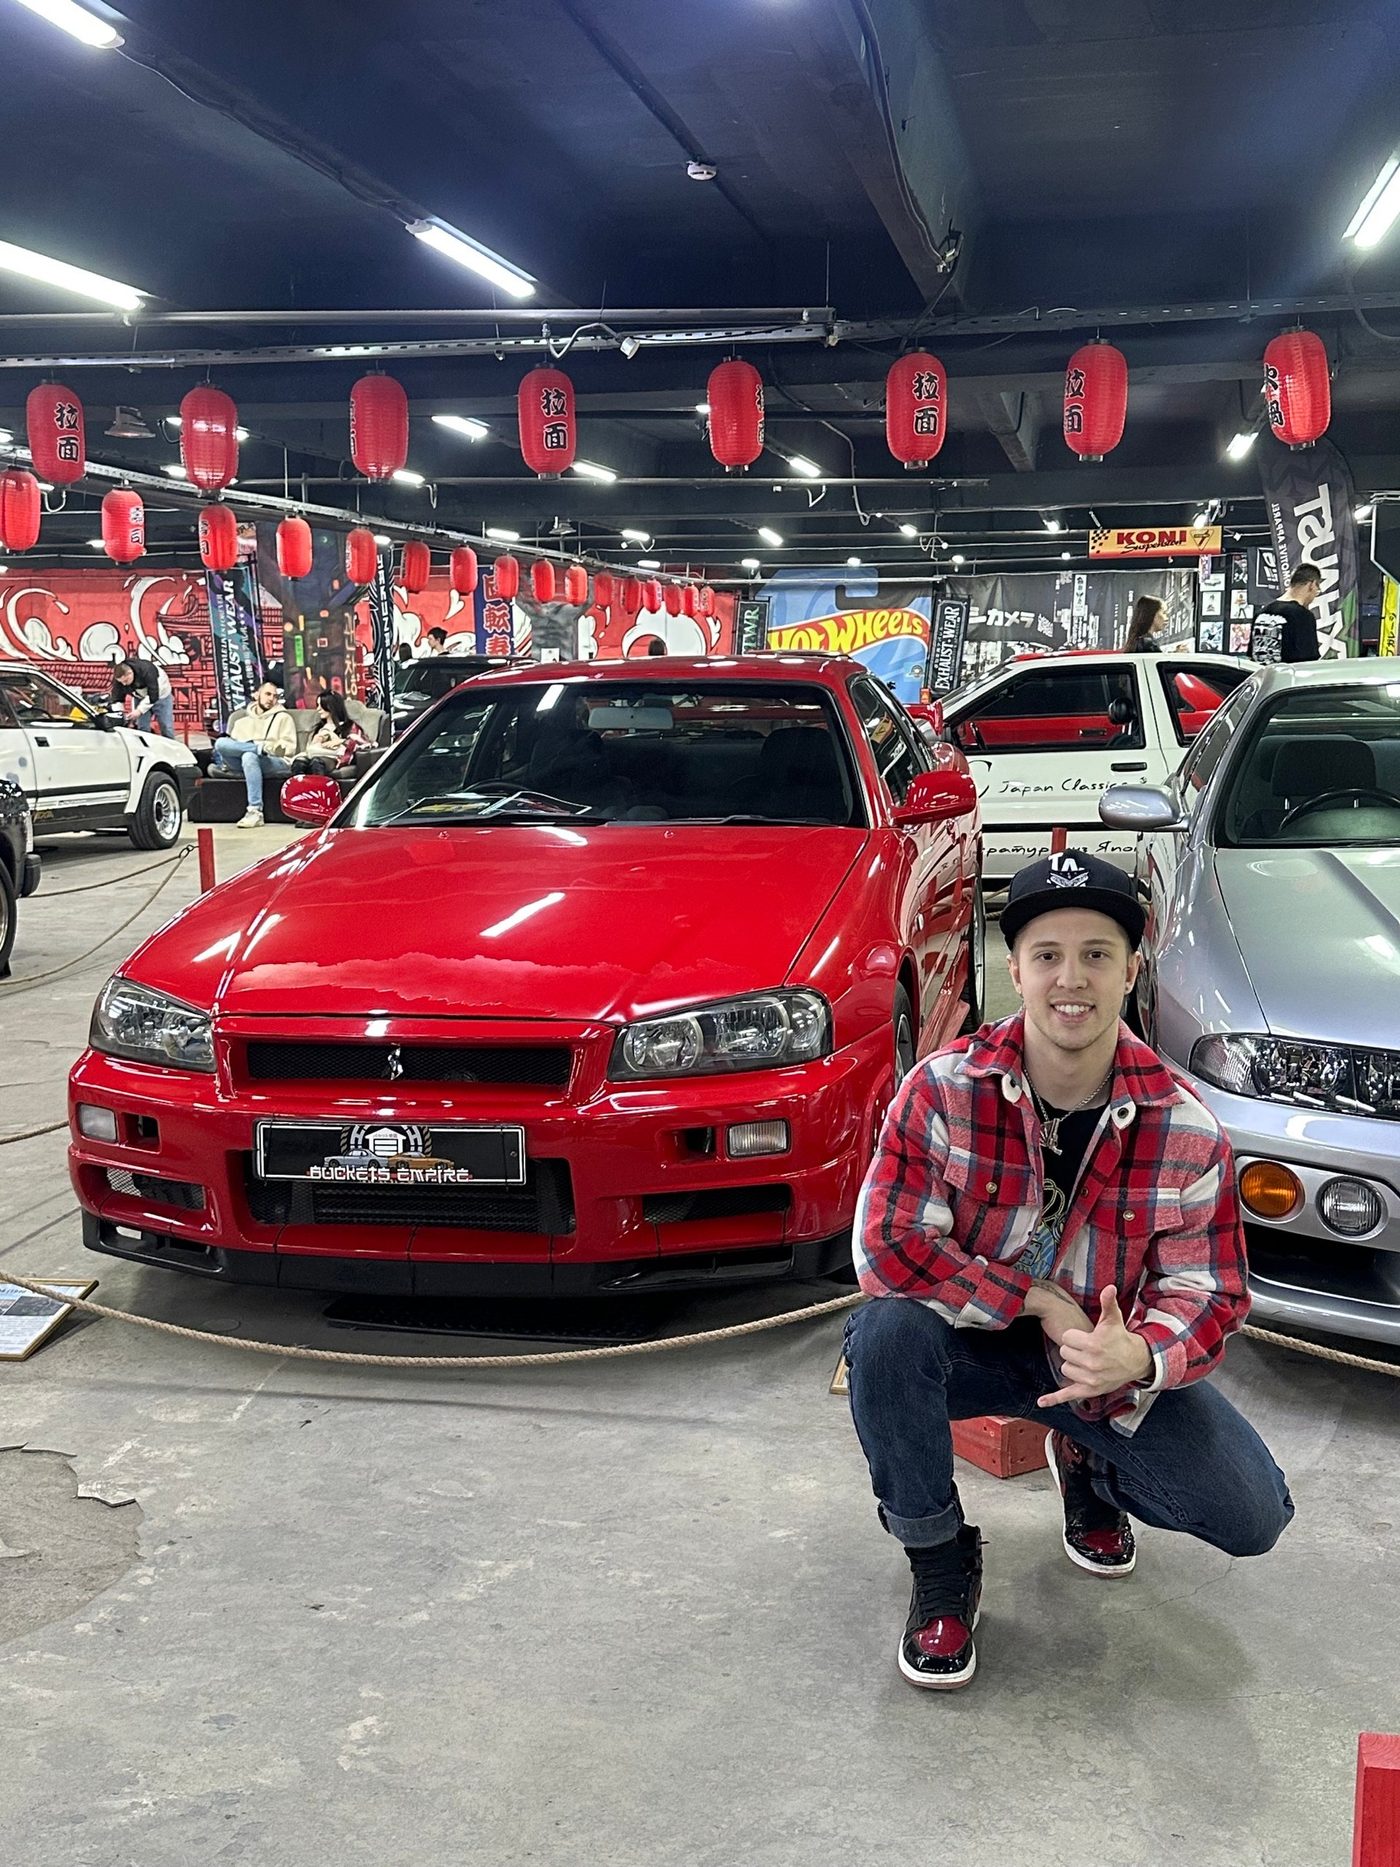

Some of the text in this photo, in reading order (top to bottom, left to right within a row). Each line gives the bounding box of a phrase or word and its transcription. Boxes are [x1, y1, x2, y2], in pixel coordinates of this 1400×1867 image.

[540, 387, 568, 451] 拉面
[912, 371, 940, 436] 拉面
[54, 401, 80, 463] 拉面
[1117, 530, 1187, 545] KONI
[224, 581, 246, 710] XHAUST WEAR
[1000, 778, 1128, 796] Japan Classic
[983, 845, 1050, 859] ратур
[1095, 840, 1137, 853] Япо
[309, 1165, 470, 1184] BUCKETS EMPIRE
